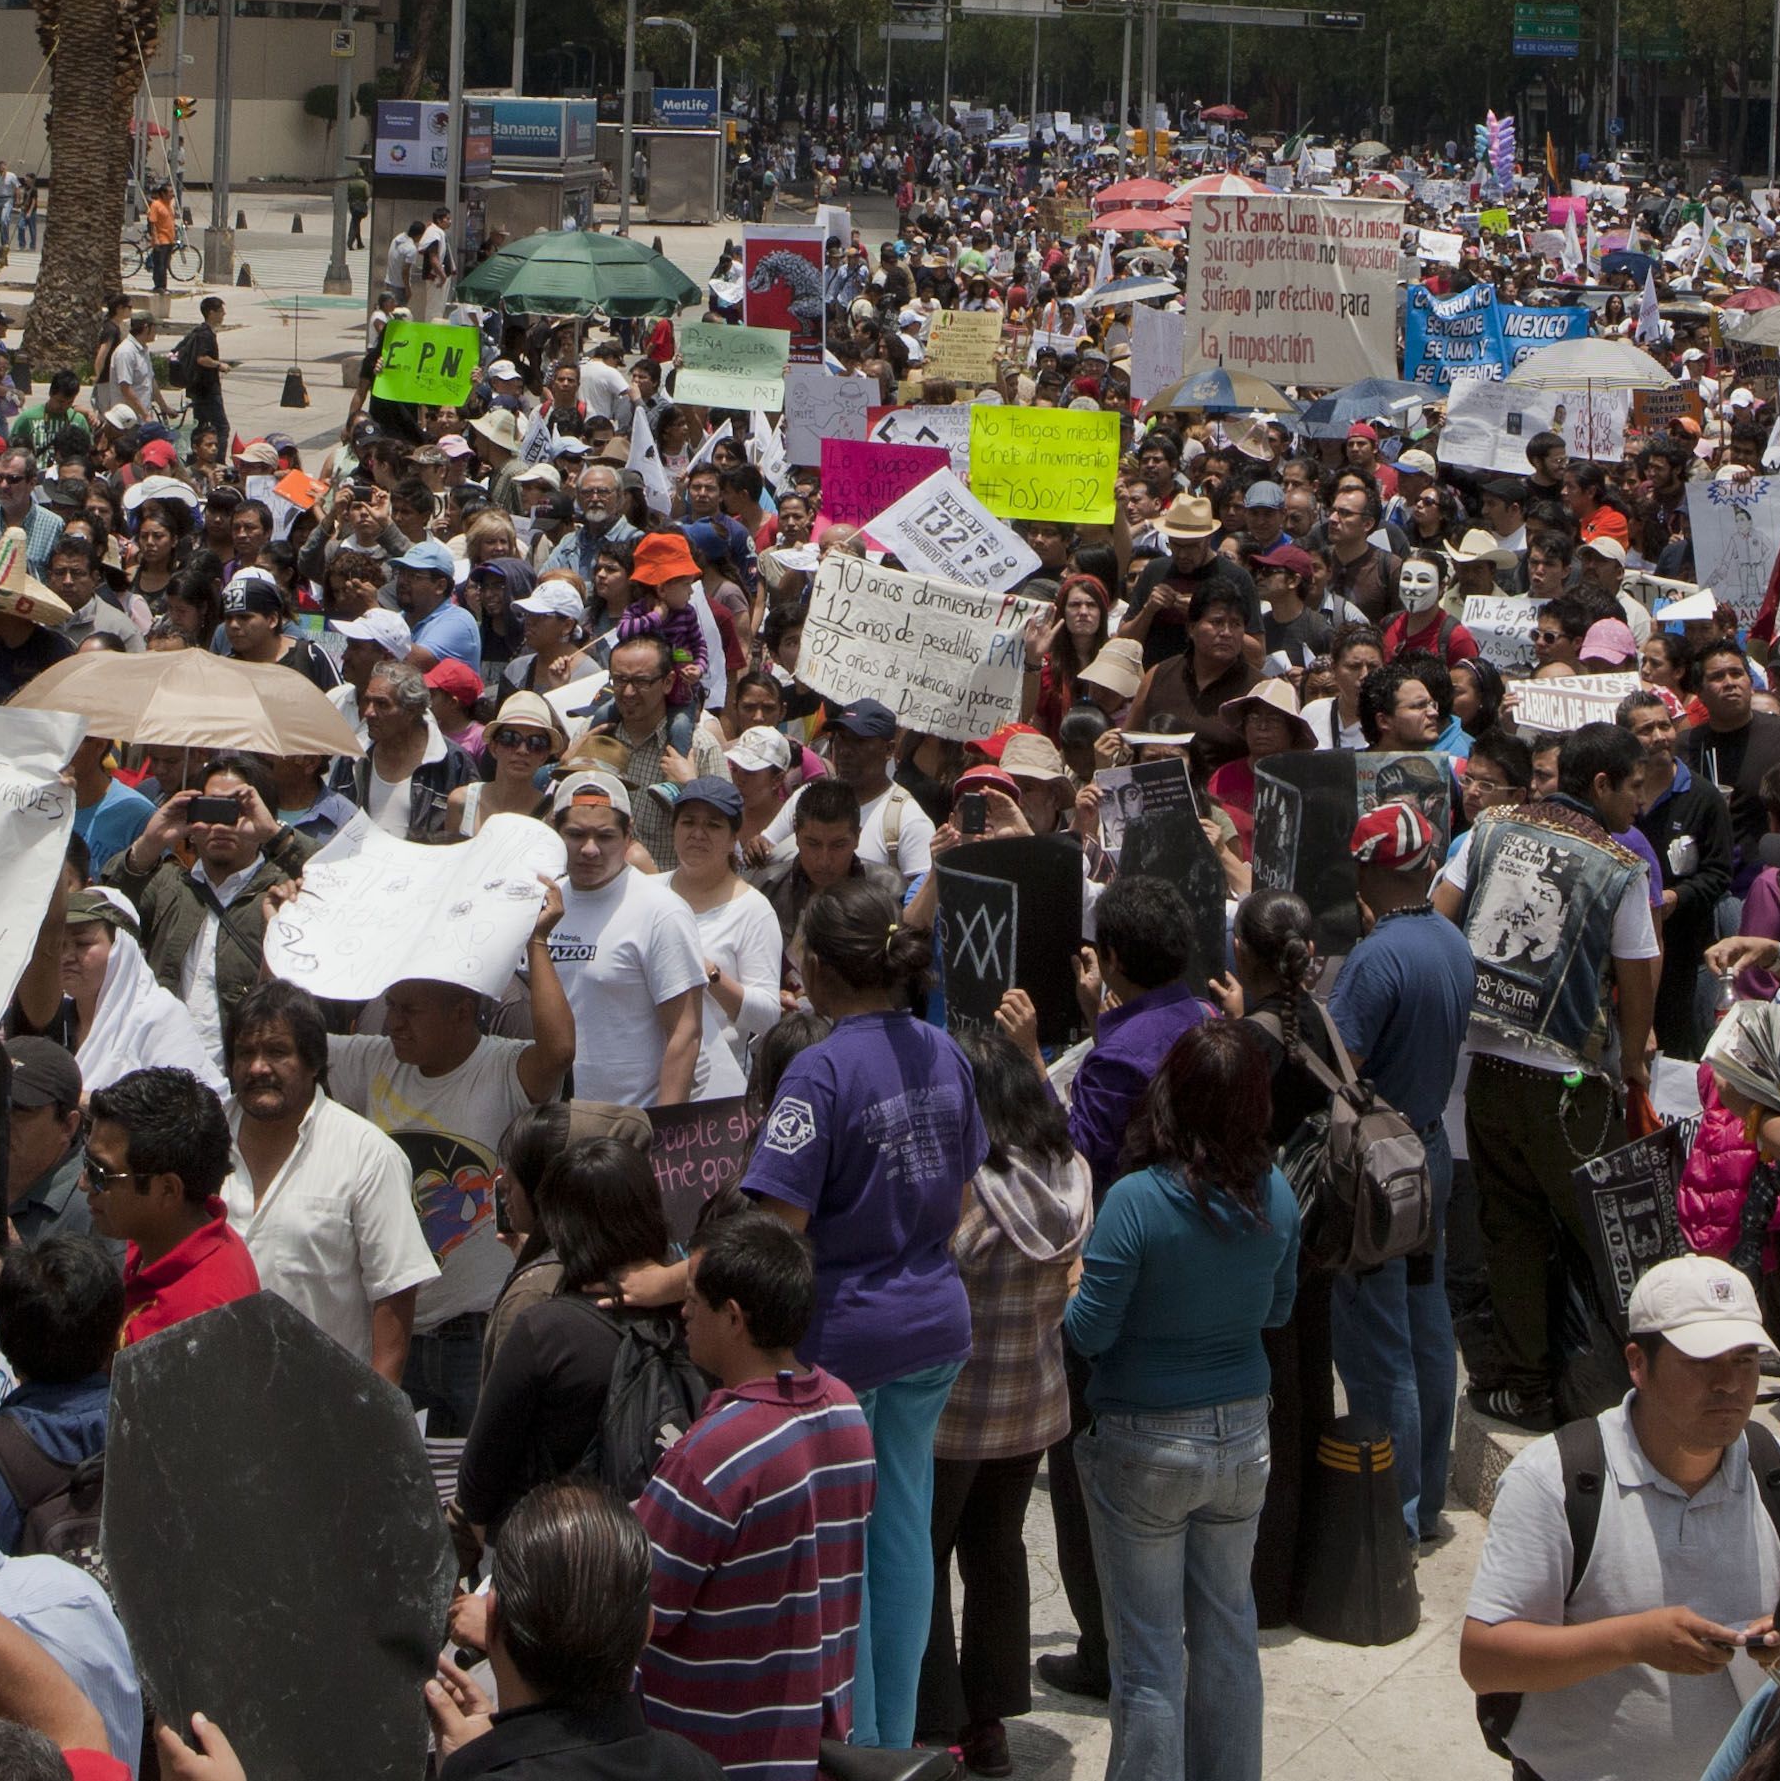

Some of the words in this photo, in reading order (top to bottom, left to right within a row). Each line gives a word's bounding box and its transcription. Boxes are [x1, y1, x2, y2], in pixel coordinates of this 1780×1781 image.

[662, 98, 709, 112] MetLife
[1203, 196, 1234, 234] Sr.
[1235, 196, 1285, 233] Ramos
[1322, 215, 1337, 237] no
[1338, 217, 1353, 238] es
[1353, 210, 1364, 239] lo
[1205, 235, 1265, 268] sufragio
[1320, 243, 1336, 264] no
[1338, 244, 1399, 275] imposición
[1201, 284, 1252, 316] sufragio
[1256, 289, 1277, 319] por
[1340, 291, 1370, 319] para
[1433, 295, 1473, 318] PATRIA
[1474, 287, 1493, 309] NO
[1426, 316, 1441, 335] SE
[1443, 314, 1484, 338] VENDE
[1503, 313, 1570, 339] MEXICO
[1228, 331, 1316, 369] imposición
[1425, 339, 1443, 359] SE
[1444, 340, 1475, 360] AMA
[1477, 338, 1490, 360] Y
[1414, 364, 1436, 384] SE
[753, 388, 778, 403] PRI
[973, 412, 1000, 437] No
[1027, 447, 1040, 463] al
[1040, 449, 1111, 468] movimiento
[978, 476, 1101, 513] #YoSoy132
[1719, 478, 1760, 497] STOP
[896, 521, 942, 564] PROHIBIDO
[915, 504, 970, 553] 132
[866, 578, 905, 603] años
[912, 579, 994, 620] durmiendo
[1495, 600, 1516, 621] te
[855, 618, 892, 644] años
[895, 612, 915, 644] de
[919, 626, 983, 665] pesadillas
[845, 653, 880, 678] años
[884, 653, 901, 681] de
[906, 663, 954, 699] violencia
[954, 687, 967, 707] y
[968, 684, 1014, 713] pobreza
[897, 688, 991, 737] Despierta
[1568, 698, 1583, 728] DE
[1498, 844, 1531, 863] FLAG
[1504, 833, 1546, 857] BLACK
[653, 1160, 694, 1193] the
